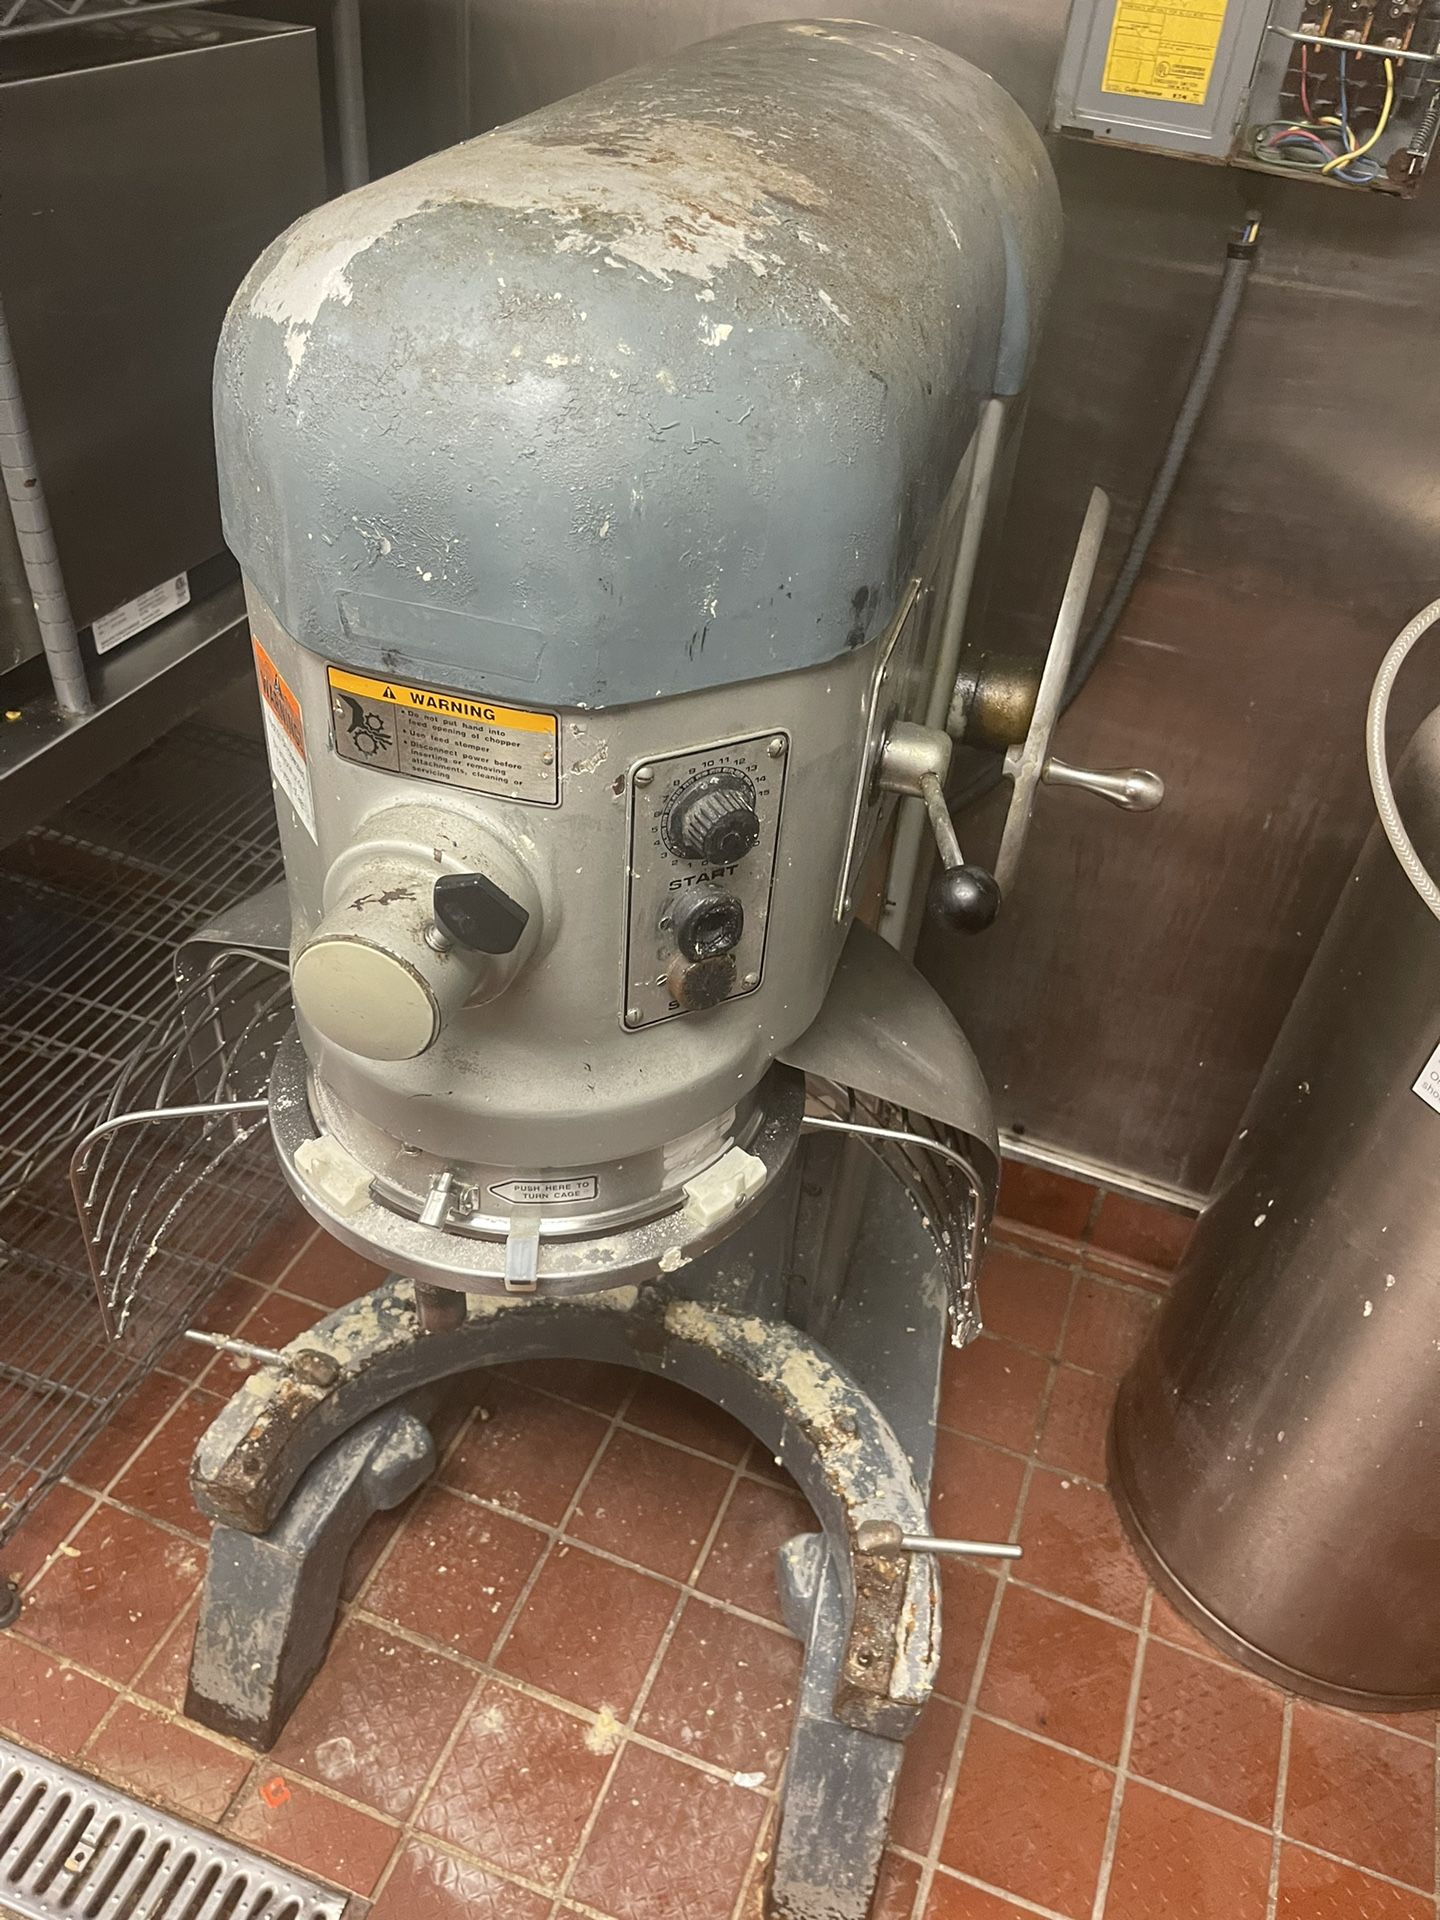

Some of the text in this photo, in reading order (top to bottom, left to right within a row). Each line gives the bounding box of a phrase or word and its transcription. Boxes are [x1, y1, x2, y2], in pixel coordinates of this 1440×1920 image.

[410, 692, 495, 721] WARNING
[408, 710, 506, 737] Do not put hand into
[408, 719, 427, 728] feed
[432, 725, 467, 738] opening
[485, 736, 521, 748] chopper
[410, 730, 490, 753] Use feed stomper
[411, 741, 522, 770] Disconnect power before
[411, 749, 448, 763] inserting
[466, 762, 506, 776] removing
[412, 758, 467, 776] attachments,
[472, 771, 509, 784] cleaning
[412, 766, 450, 780] servicing
[662, 795, 669, 803] 7
[755, 775, 766, 783] 14
[668, 864, 739, 891] START
[1430, 1071, 1440, 1085] O
[1422, 1081, 1440, 1103] sho
[545, 1183, 571, 1191] HERE
[554, 1190, 581, 1198] CAGE
